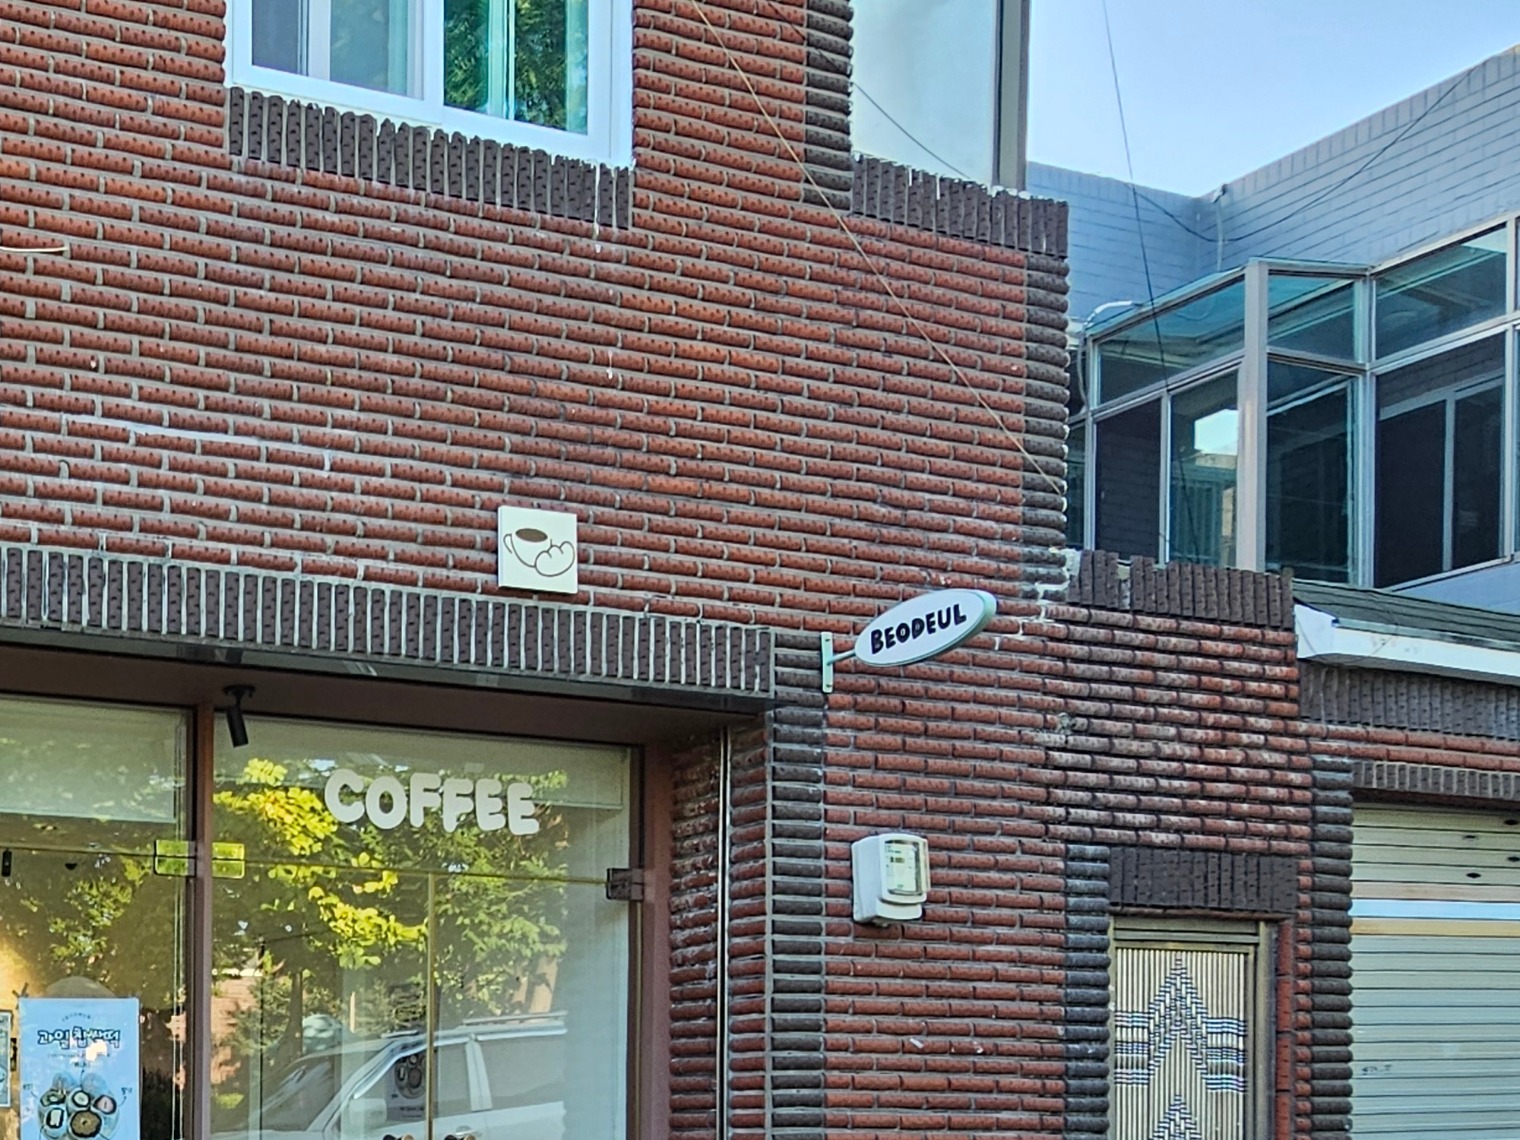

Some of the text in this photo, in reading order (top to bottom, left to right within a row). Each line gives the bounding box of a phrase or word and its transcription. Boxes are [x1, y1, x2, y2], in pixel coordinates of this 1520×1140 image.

[870, 603, 967, 656] BEODEUL
[324, 768, 542, 837] COFFEE
[37, 1029, 70, 1050] 과일
